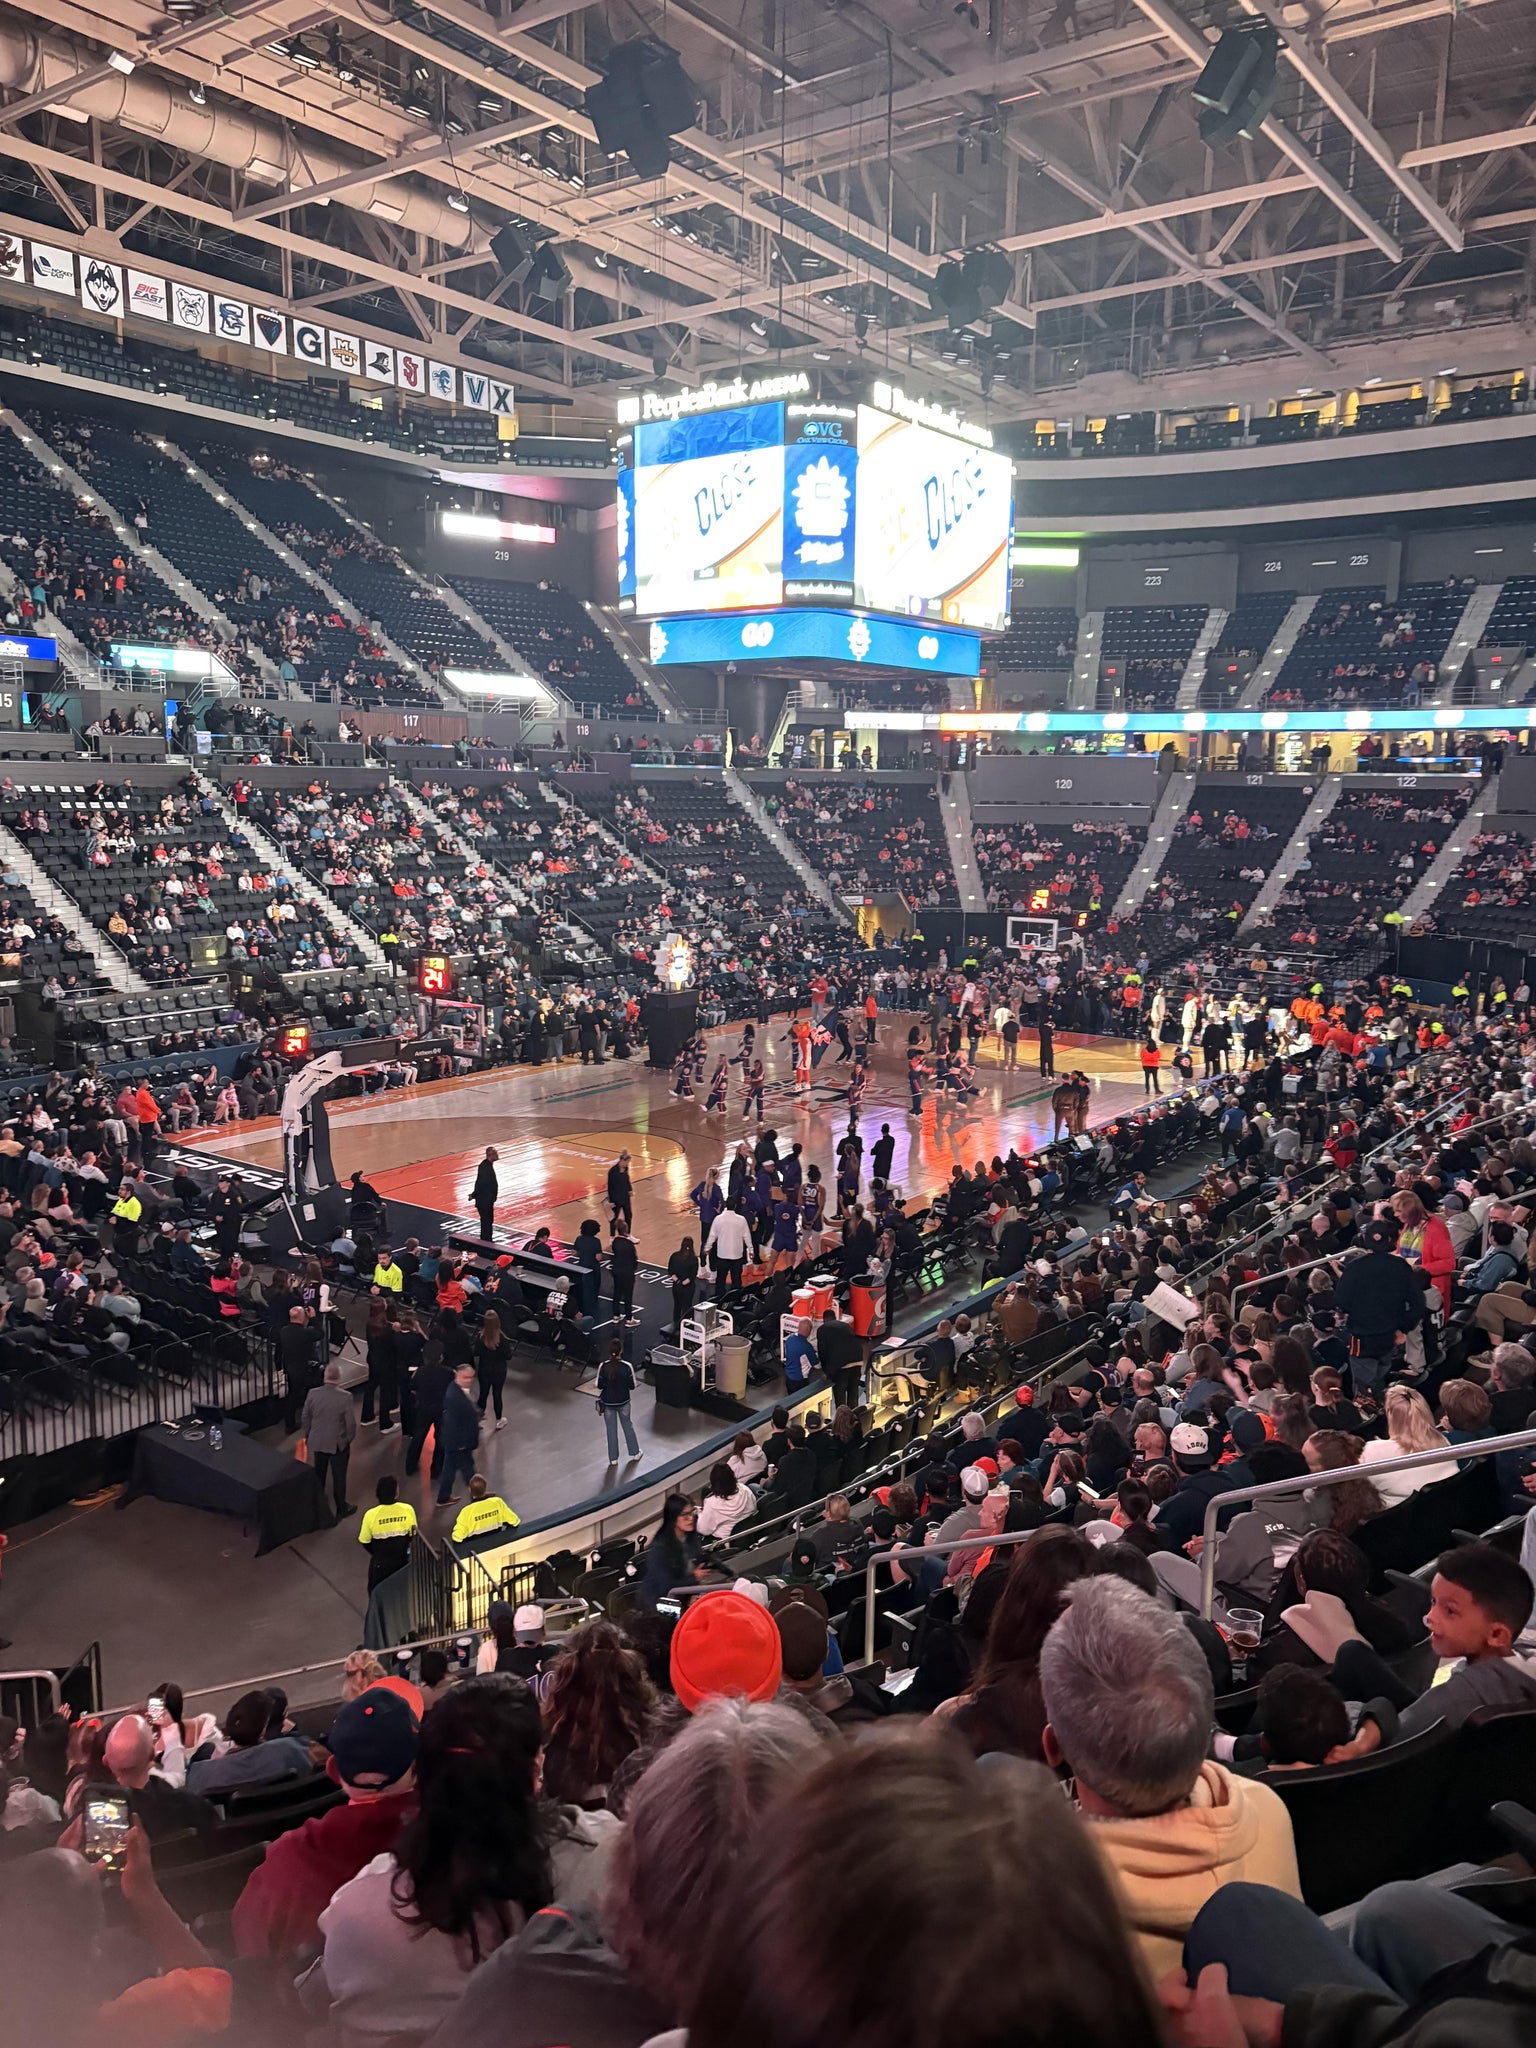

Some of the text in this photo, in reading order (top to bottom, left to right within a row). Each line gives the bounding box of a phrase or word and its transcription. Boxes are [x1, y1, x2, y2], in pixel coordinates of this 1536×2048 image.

[137, 283, 159, 295] BIG
[134, 290, 165, 304] EAST
[297, 326, 322, 360] G
[465, 375, 486, 405] V
[750, 373, 810, 400] ARENA
[491, 382, 512, 413] X
[803, 421, 843, 438] OVG
[494, 550, 510, 561] 219
[1350, 555, 1369, 566] 225
[1264, 561, 1282, 572] 224
[1144, 576, 1162, 586] 223
[403, 714, 419, 727] 117
[576, 725, 589, 736] 118
[1055, 779, 1073, 789] 120
[1246, 775, 1263, 785] 121
[1397, 776, 1416, 788] 122
[424, 968, 443, 990] 24
[287, 1038, 302, 1052] 24
[803, 1187, 817, 1198] 30
[378, 1516, 407, 1526] SECURITY
[474, 1510, 500, 1522] SECURITY
